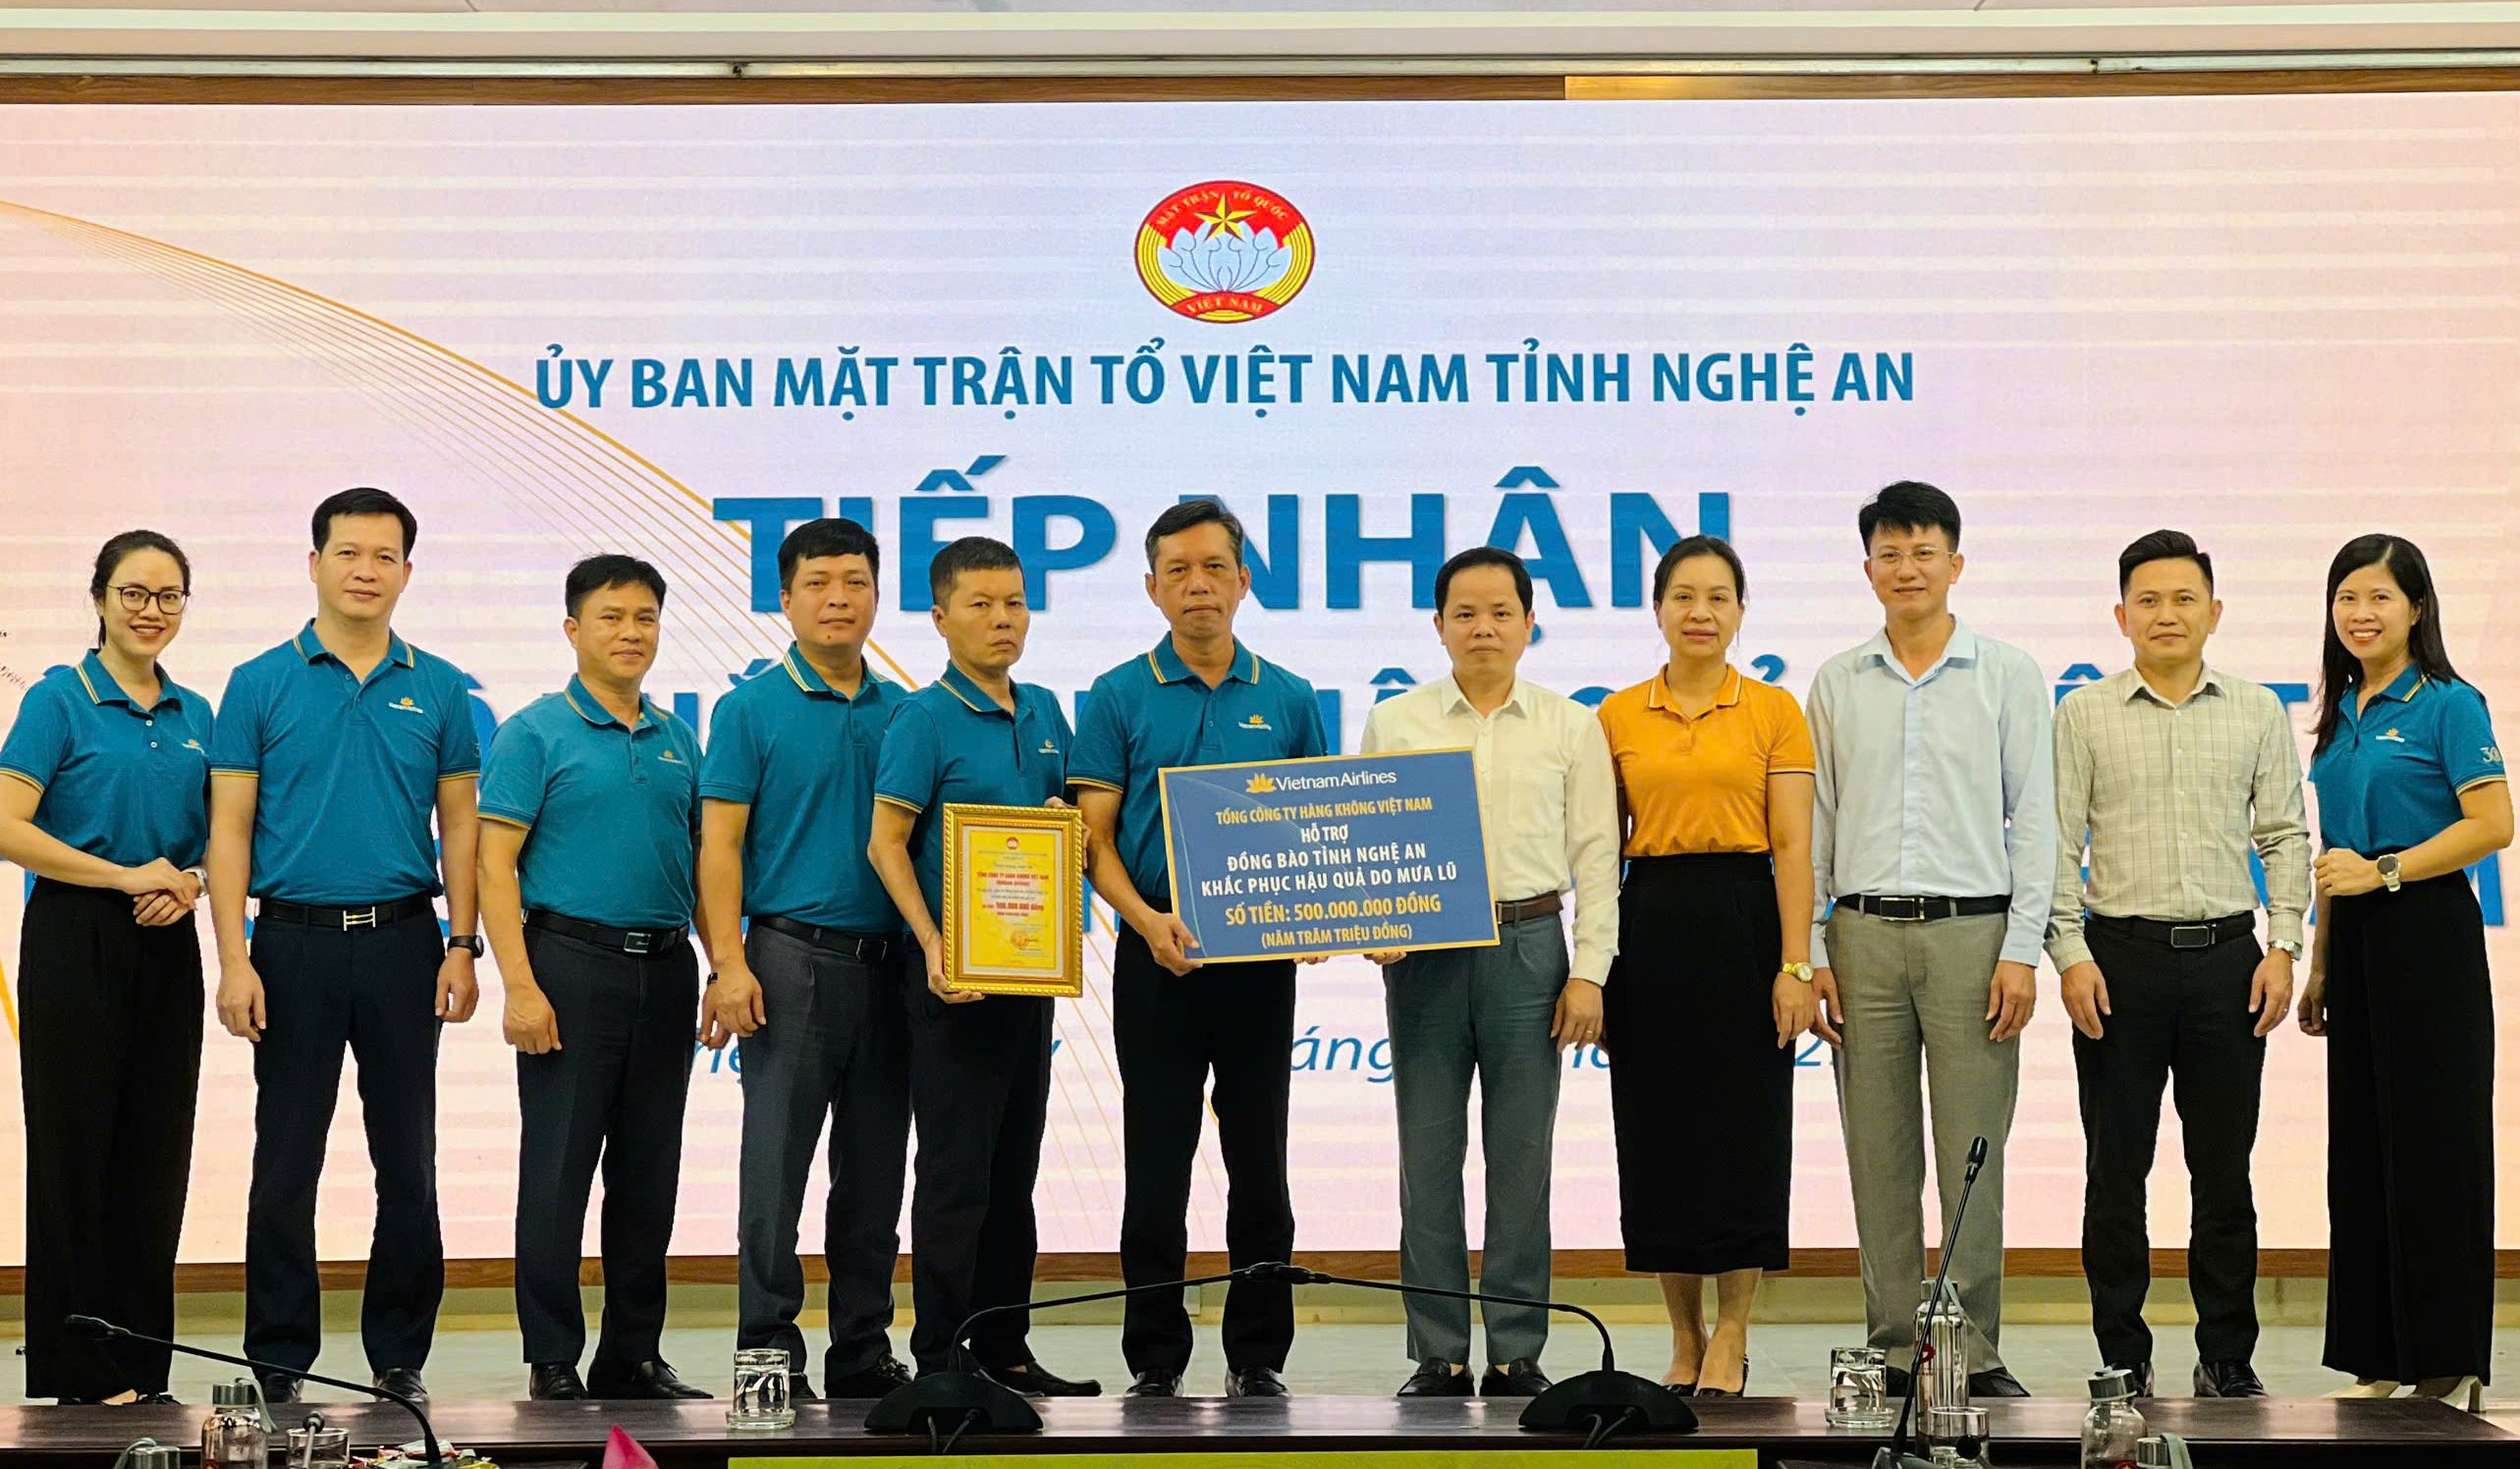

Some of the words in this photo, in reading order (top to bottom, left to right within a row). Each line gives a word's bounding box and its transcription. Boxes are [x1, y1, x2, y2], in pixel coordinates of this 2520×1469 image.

[536, 343, 614, 409] ỦY
[631, 357, 753, 408] BAN
[773, 345, 899, 421] MẶT
[913, 346, 1073, 420] TRẬN
[1090, 336, 1167, 407] TỔ
[1179, 344, 1313, 418] VIỆT
[1331, 353, 1469, 405] NAM
[1485, 337, 1630, 404] TỈNH
[1653, 342, 1815, 417] NGHỆ
[1831, 352, 1914, 403] AN
[713, 455, 1117, 612] TẾP
[1276, 774, 1340, 791] Vietnam
[1340, 770, 1397, 787] Airlines
[1215, 806, 1248, 825] TỔNG
[1249, 805, 1282, 823] CÔNG
[1282, 806, 1297, 821] TY
[1299, 802, 1334, 819] HÀNG
[1335, 799, 1376, 817] KHÔNG
[1376, 796, 1403, 816] VIỆT
[1403, 796, 1433, 812] NAM
[1300, 822, 1321, 843] HỖ
[1321, 823, 1349, 844] TRỢ
[1227, 850, 1273, 872] ĐỒNG
[1276, 848, 1310, 869] BÀO
[1356, 842, 1400, 864] NGHỆ
[1404, 843, 1427, 860] AN
[1201, 874, 1244, 898] KHẮC
[1247, 874, 1291, 897] PHỤC
[1294, 870, 1329, 894] HẬU
[1332, 866, 1367, 889] QUẢ
[1369, 868, 1393, 887] DO
[1397, 864, 1434, 884] MƯA
[1437, 860, 1457, 881] LŨ
[1225, 900, 1247, 926] SỐ
[1247, 899, 1291, 924] TIỀN:
[1293, 897, 1394, 921] 500.000.000
[1395, 890, 1443, 914] ĐỒNG
[1261, 929, 1295, 949] (NĂM
[1296, 927, 1334, 945] TRĂM
[1334, 924, 1371, 945] TRIỆU
[1372, 921, 1413, 941] ĐỒNG)
[1290, 1026, 1395, 1082] áng
